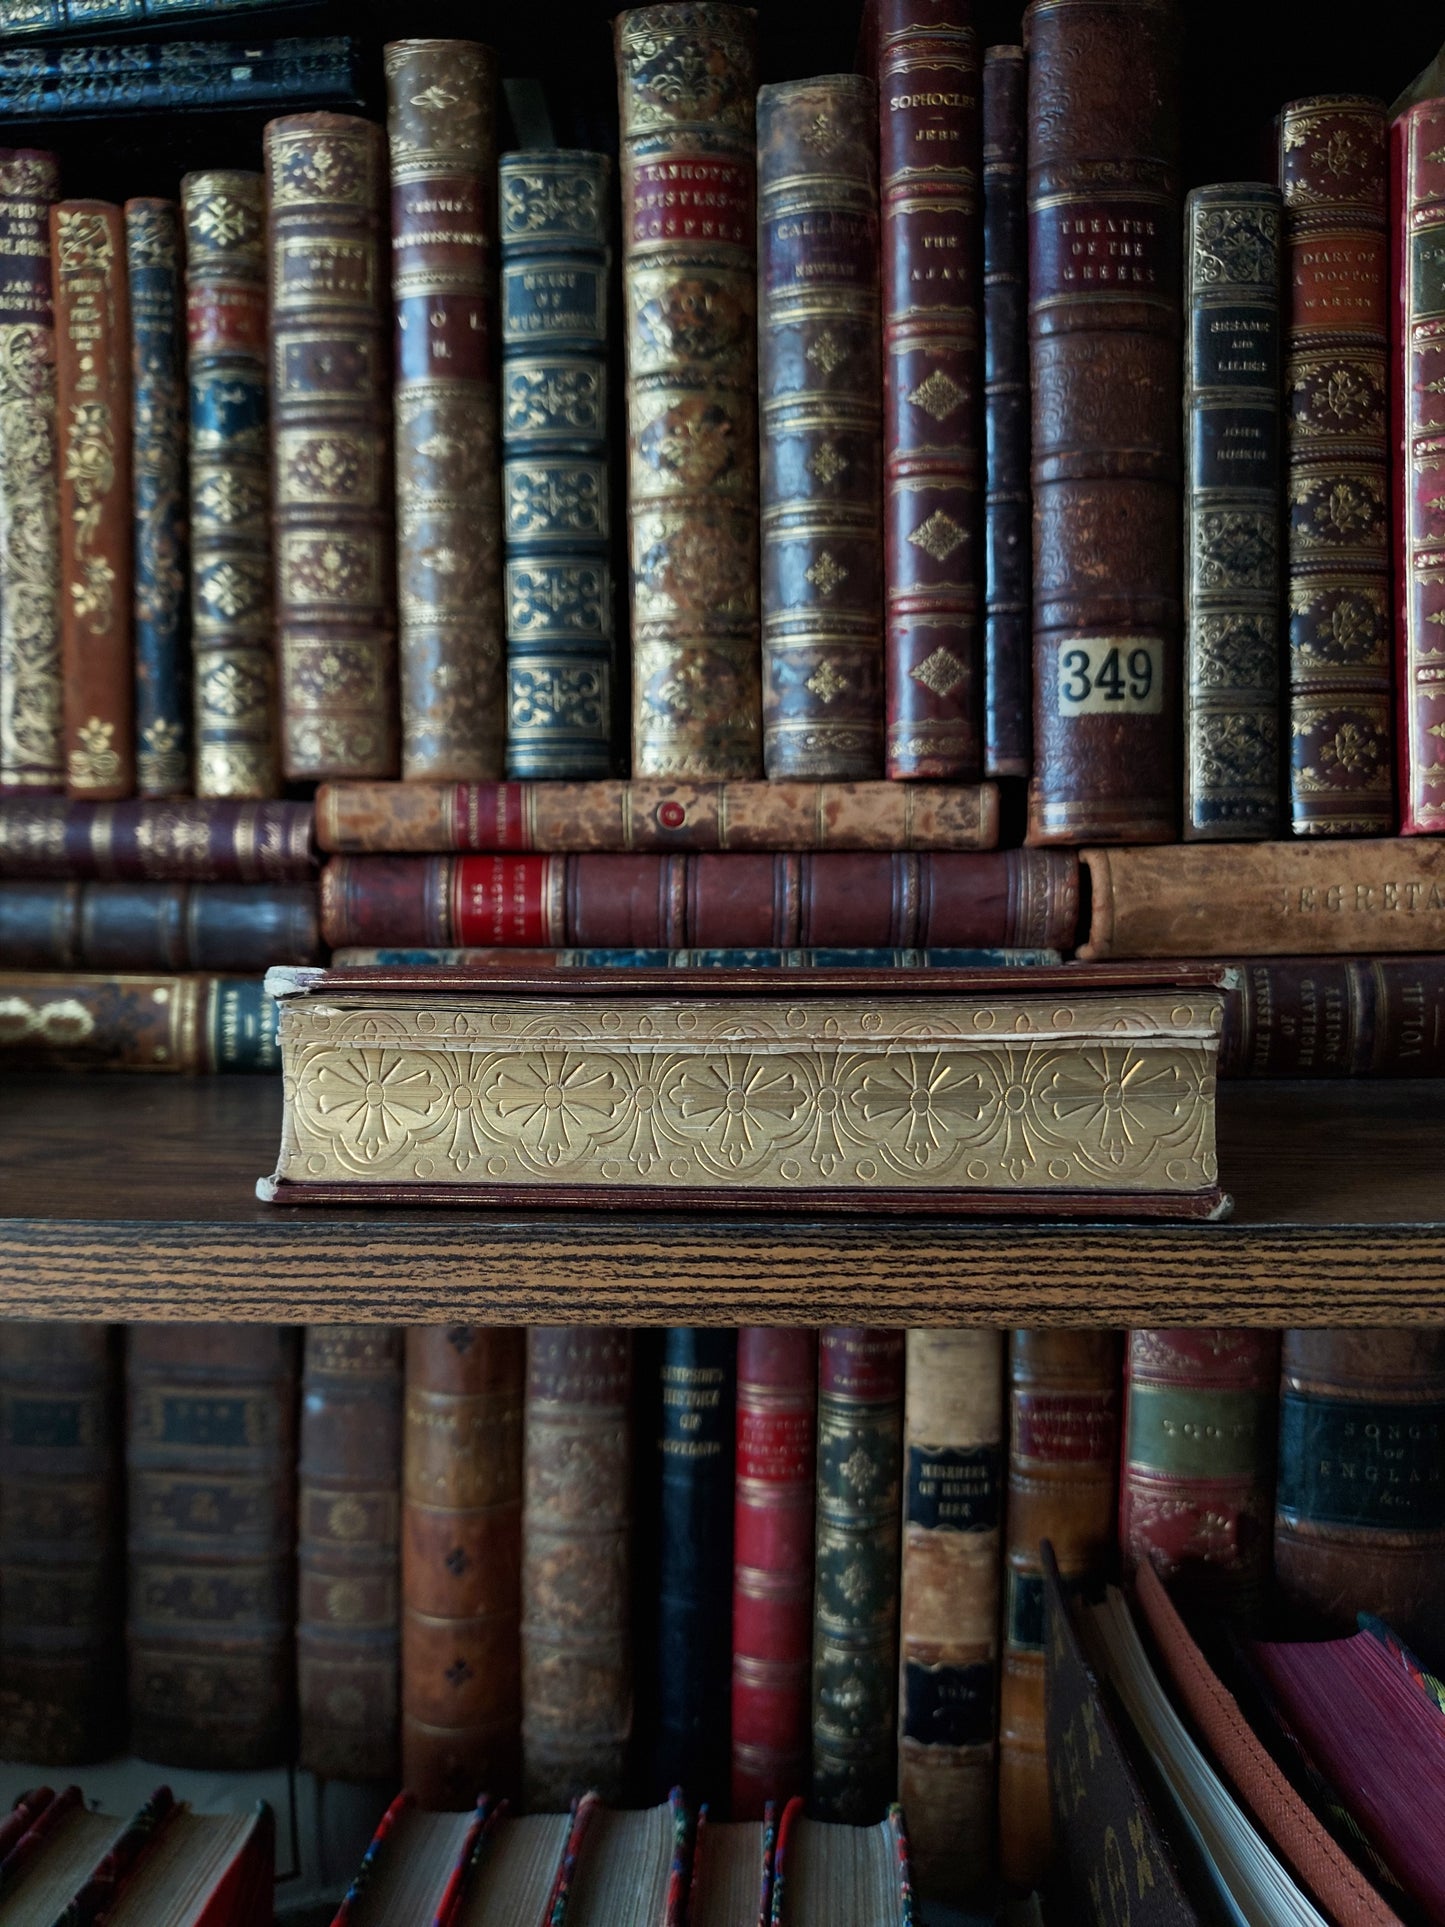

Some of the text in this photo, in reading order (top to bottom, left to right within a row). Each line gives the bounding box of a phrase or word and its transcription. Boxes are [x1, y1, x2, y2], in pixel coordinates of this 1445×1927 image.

[890, 93, 975, 112] SOPHOCLES
[634, 219, 743, 240] GOSPELS
[1060, 218, 1155, 236] THEATRE
[922, 235, 957, 248] THE
[1072, 241, 1143, 257] OF THE
[1302, 250, 1376, 265] DIARY OF
[911, 268, 968, 281] AJAX
[1063, 264, 1155, 281] GREEKS
[1292, 270, 1380, 287] A DOCTOR
[1304, 296, 1371, 308] WARREN
[1210, 320, 1271, 333] SESAME
[1231, 339, 1254, 349] AND
[1062, 647, 1152, 702] 349
[1253, 967, 1272, 1069] RIZE ESSAYS
[1280, 1014, 1296, 1036] OF
[1296, 979, 1318, 1066] HIGHLAND
[1322, 986, 1342, 1063] SOCIETY
[1345, 1423, 1439, 1441] SONGS
[918, 1480, 937, 1496] OF
